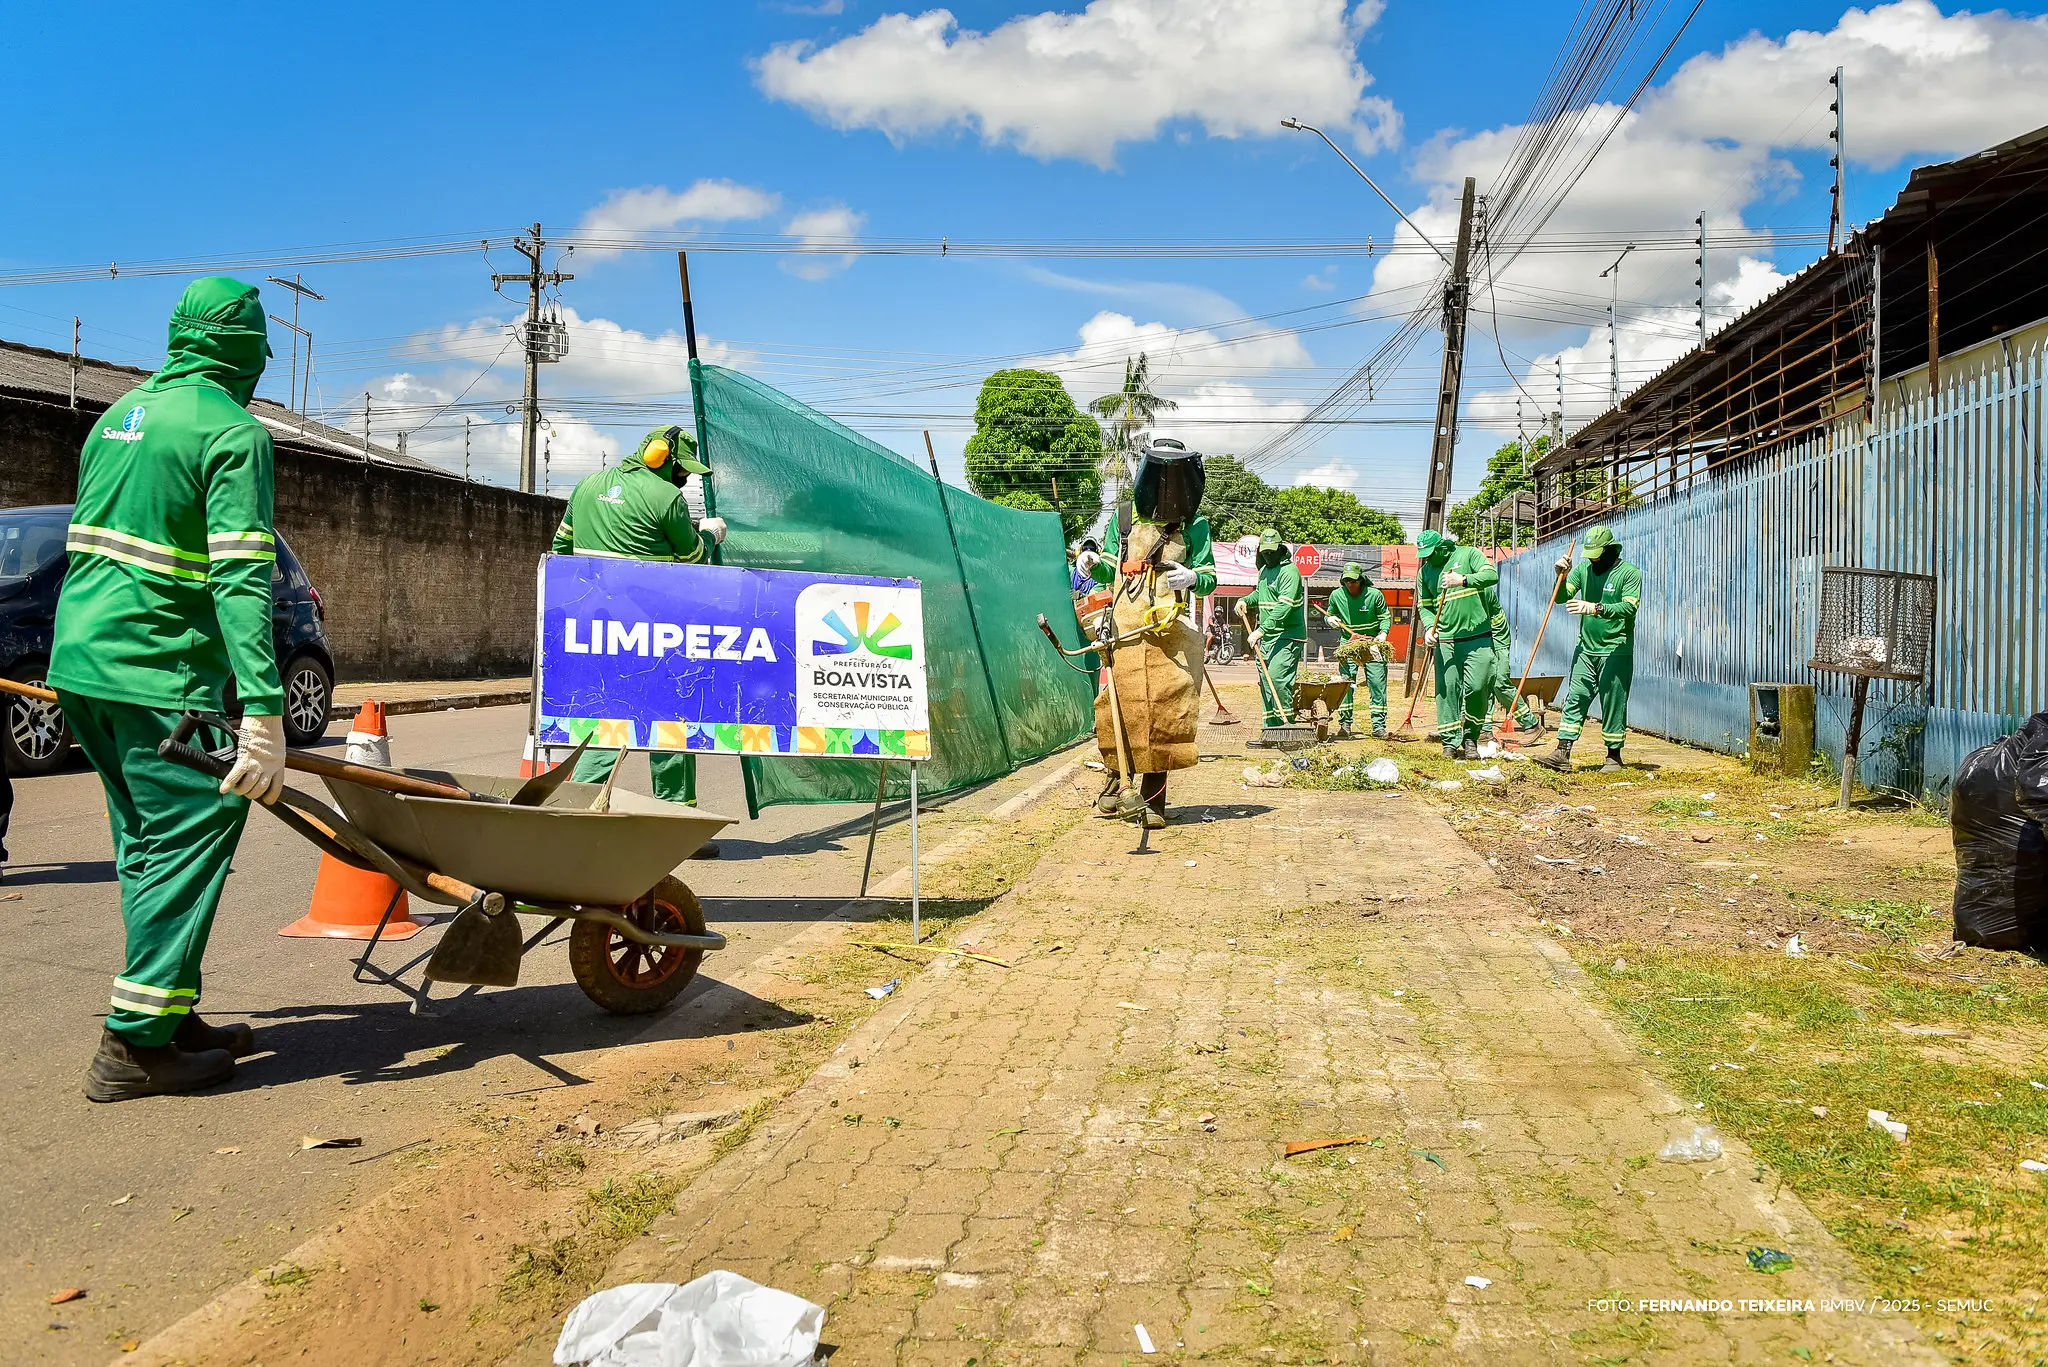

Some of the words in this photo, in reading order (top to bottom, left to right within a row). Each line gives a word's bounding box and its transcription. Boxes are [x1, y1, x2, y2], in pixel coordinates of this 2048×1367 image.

[1295, 555, 1319, 565] PARE
[564, 618, 778, 662] LIMPEZA
[817, 701, 875, 709] CONSERVAÇÃO
[877, 702, 909, 710] PÚBLICA
